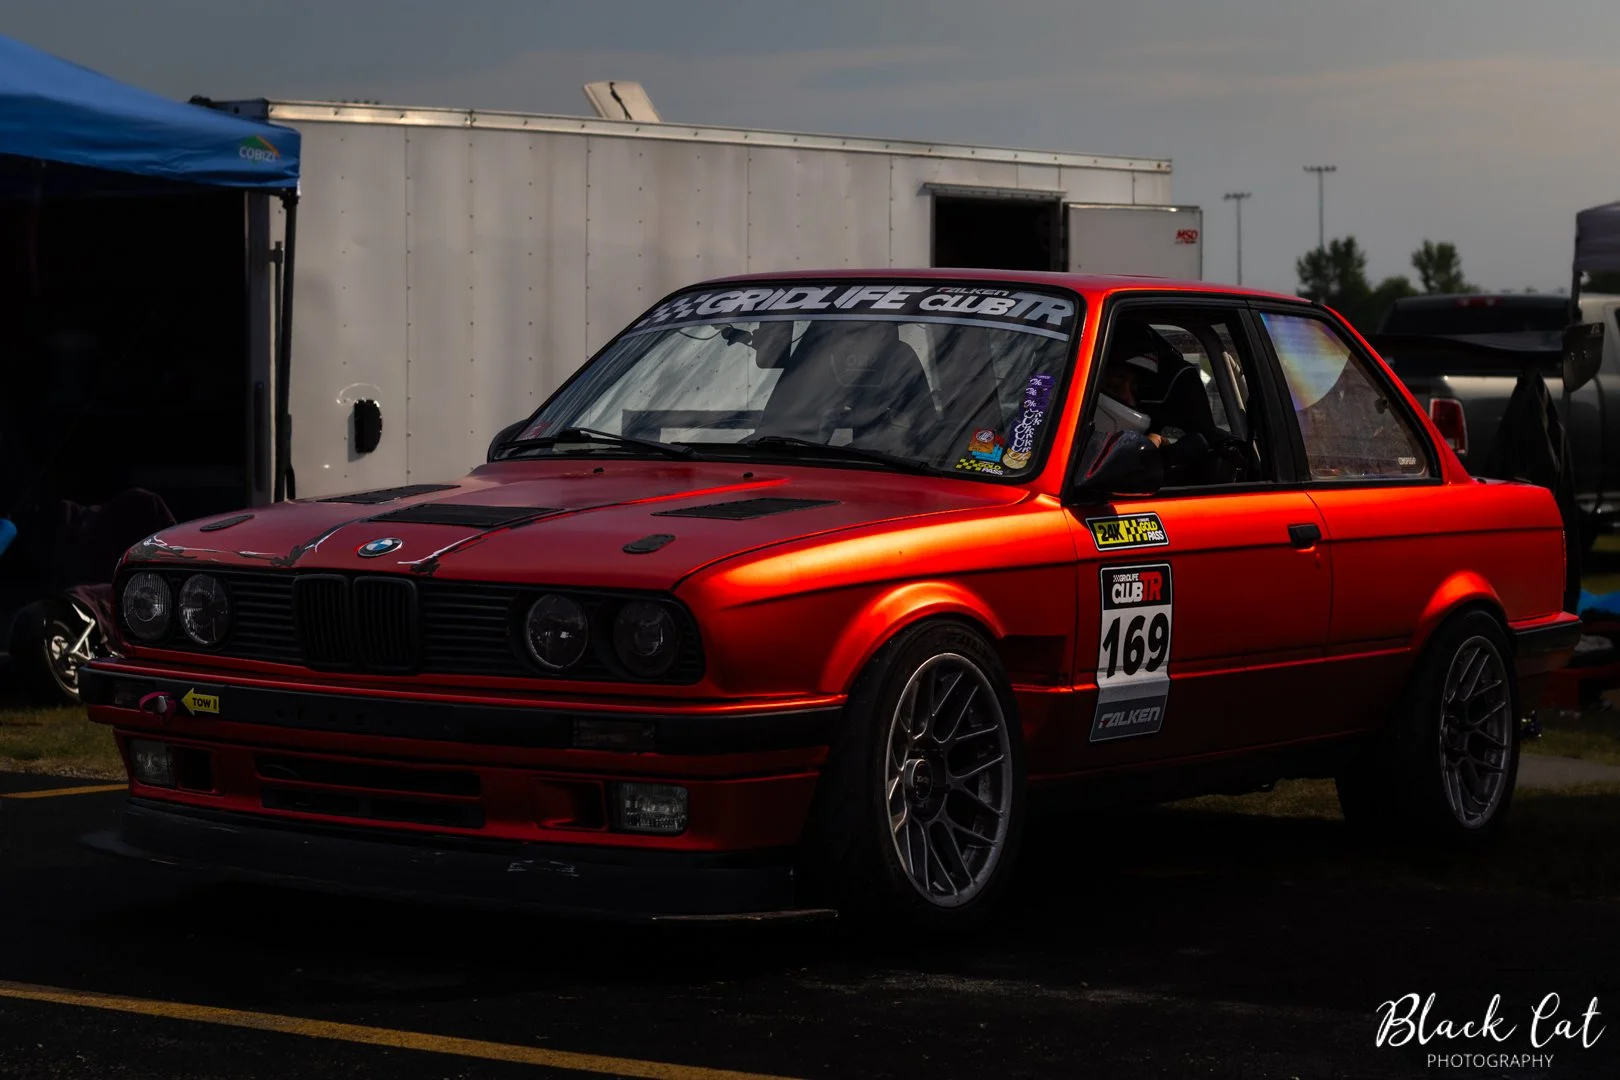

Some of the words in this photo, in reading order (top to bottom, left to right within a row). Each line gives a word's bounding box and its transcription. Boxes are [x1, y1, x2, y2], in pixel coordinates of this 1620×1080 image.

[696, 285, 933, 315] GRIDLIFE
[936, 286, 1010, 297] FALKEN
[1098, 523, 1126, 542] 24K
[1138, 520, 1159, 532] GOLD
[1147, 531, 1165, 542] PASS
[1102, 612, 1170, 679] 169
[192, 697, 211, 708] TOW
[1098, 706, 1161, 729] FALKEN
